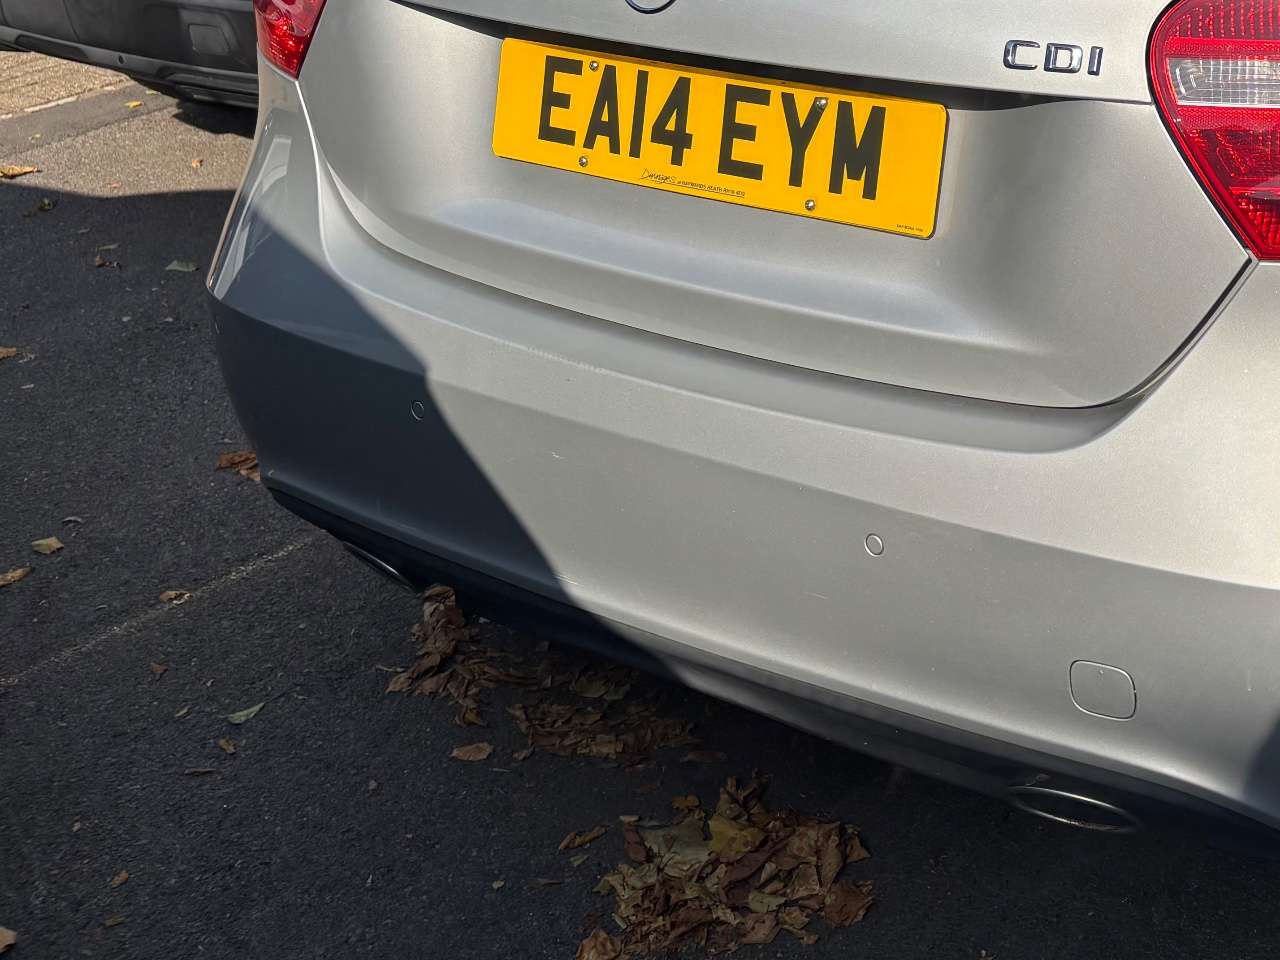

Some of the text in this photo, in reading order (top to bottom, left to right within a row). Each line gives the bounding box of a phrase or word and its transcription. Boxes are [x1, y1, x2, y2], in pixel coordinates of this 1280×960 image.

[1003, 39, 1104, 76] CDI
[538, 55, 887, 201] EA14 EYM
